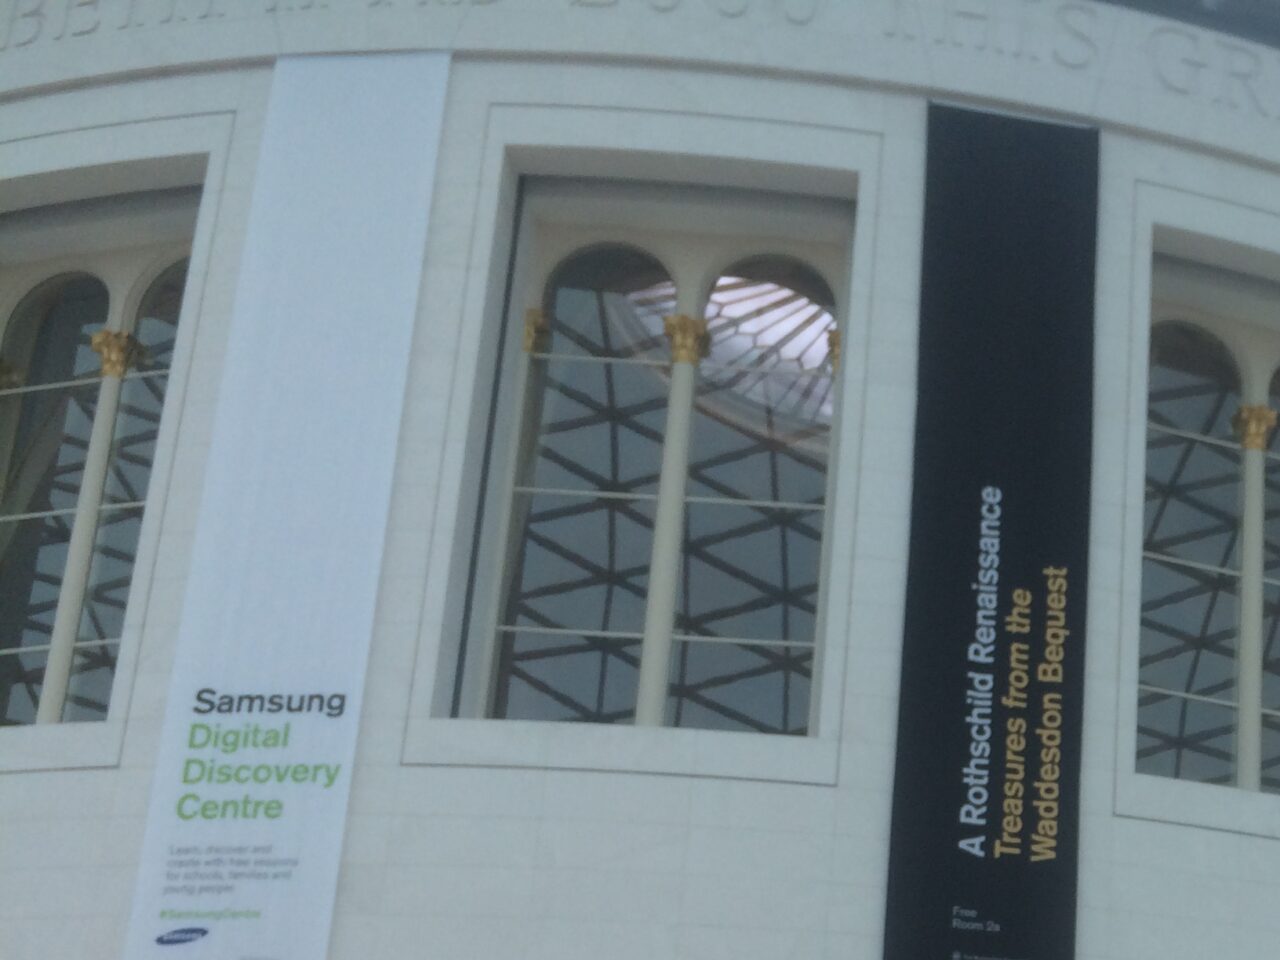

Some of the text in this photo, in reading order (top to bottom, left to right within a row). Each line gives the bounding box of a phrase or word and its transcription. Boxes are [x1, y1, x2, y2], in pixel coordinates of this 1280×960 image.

[958, 486, 1003, 857] A Rothschild Renaissance
[192, 688, 346, 718] Samsung
[1030, 565, 1070, 862] Waddesdon Bequest
[187, 722, 291, 753] Digital
[993, 588, 1033, 859] Treasures from the
[181, 758, 341, 788] Discovery
[176, 793, 284, 821] Centre
